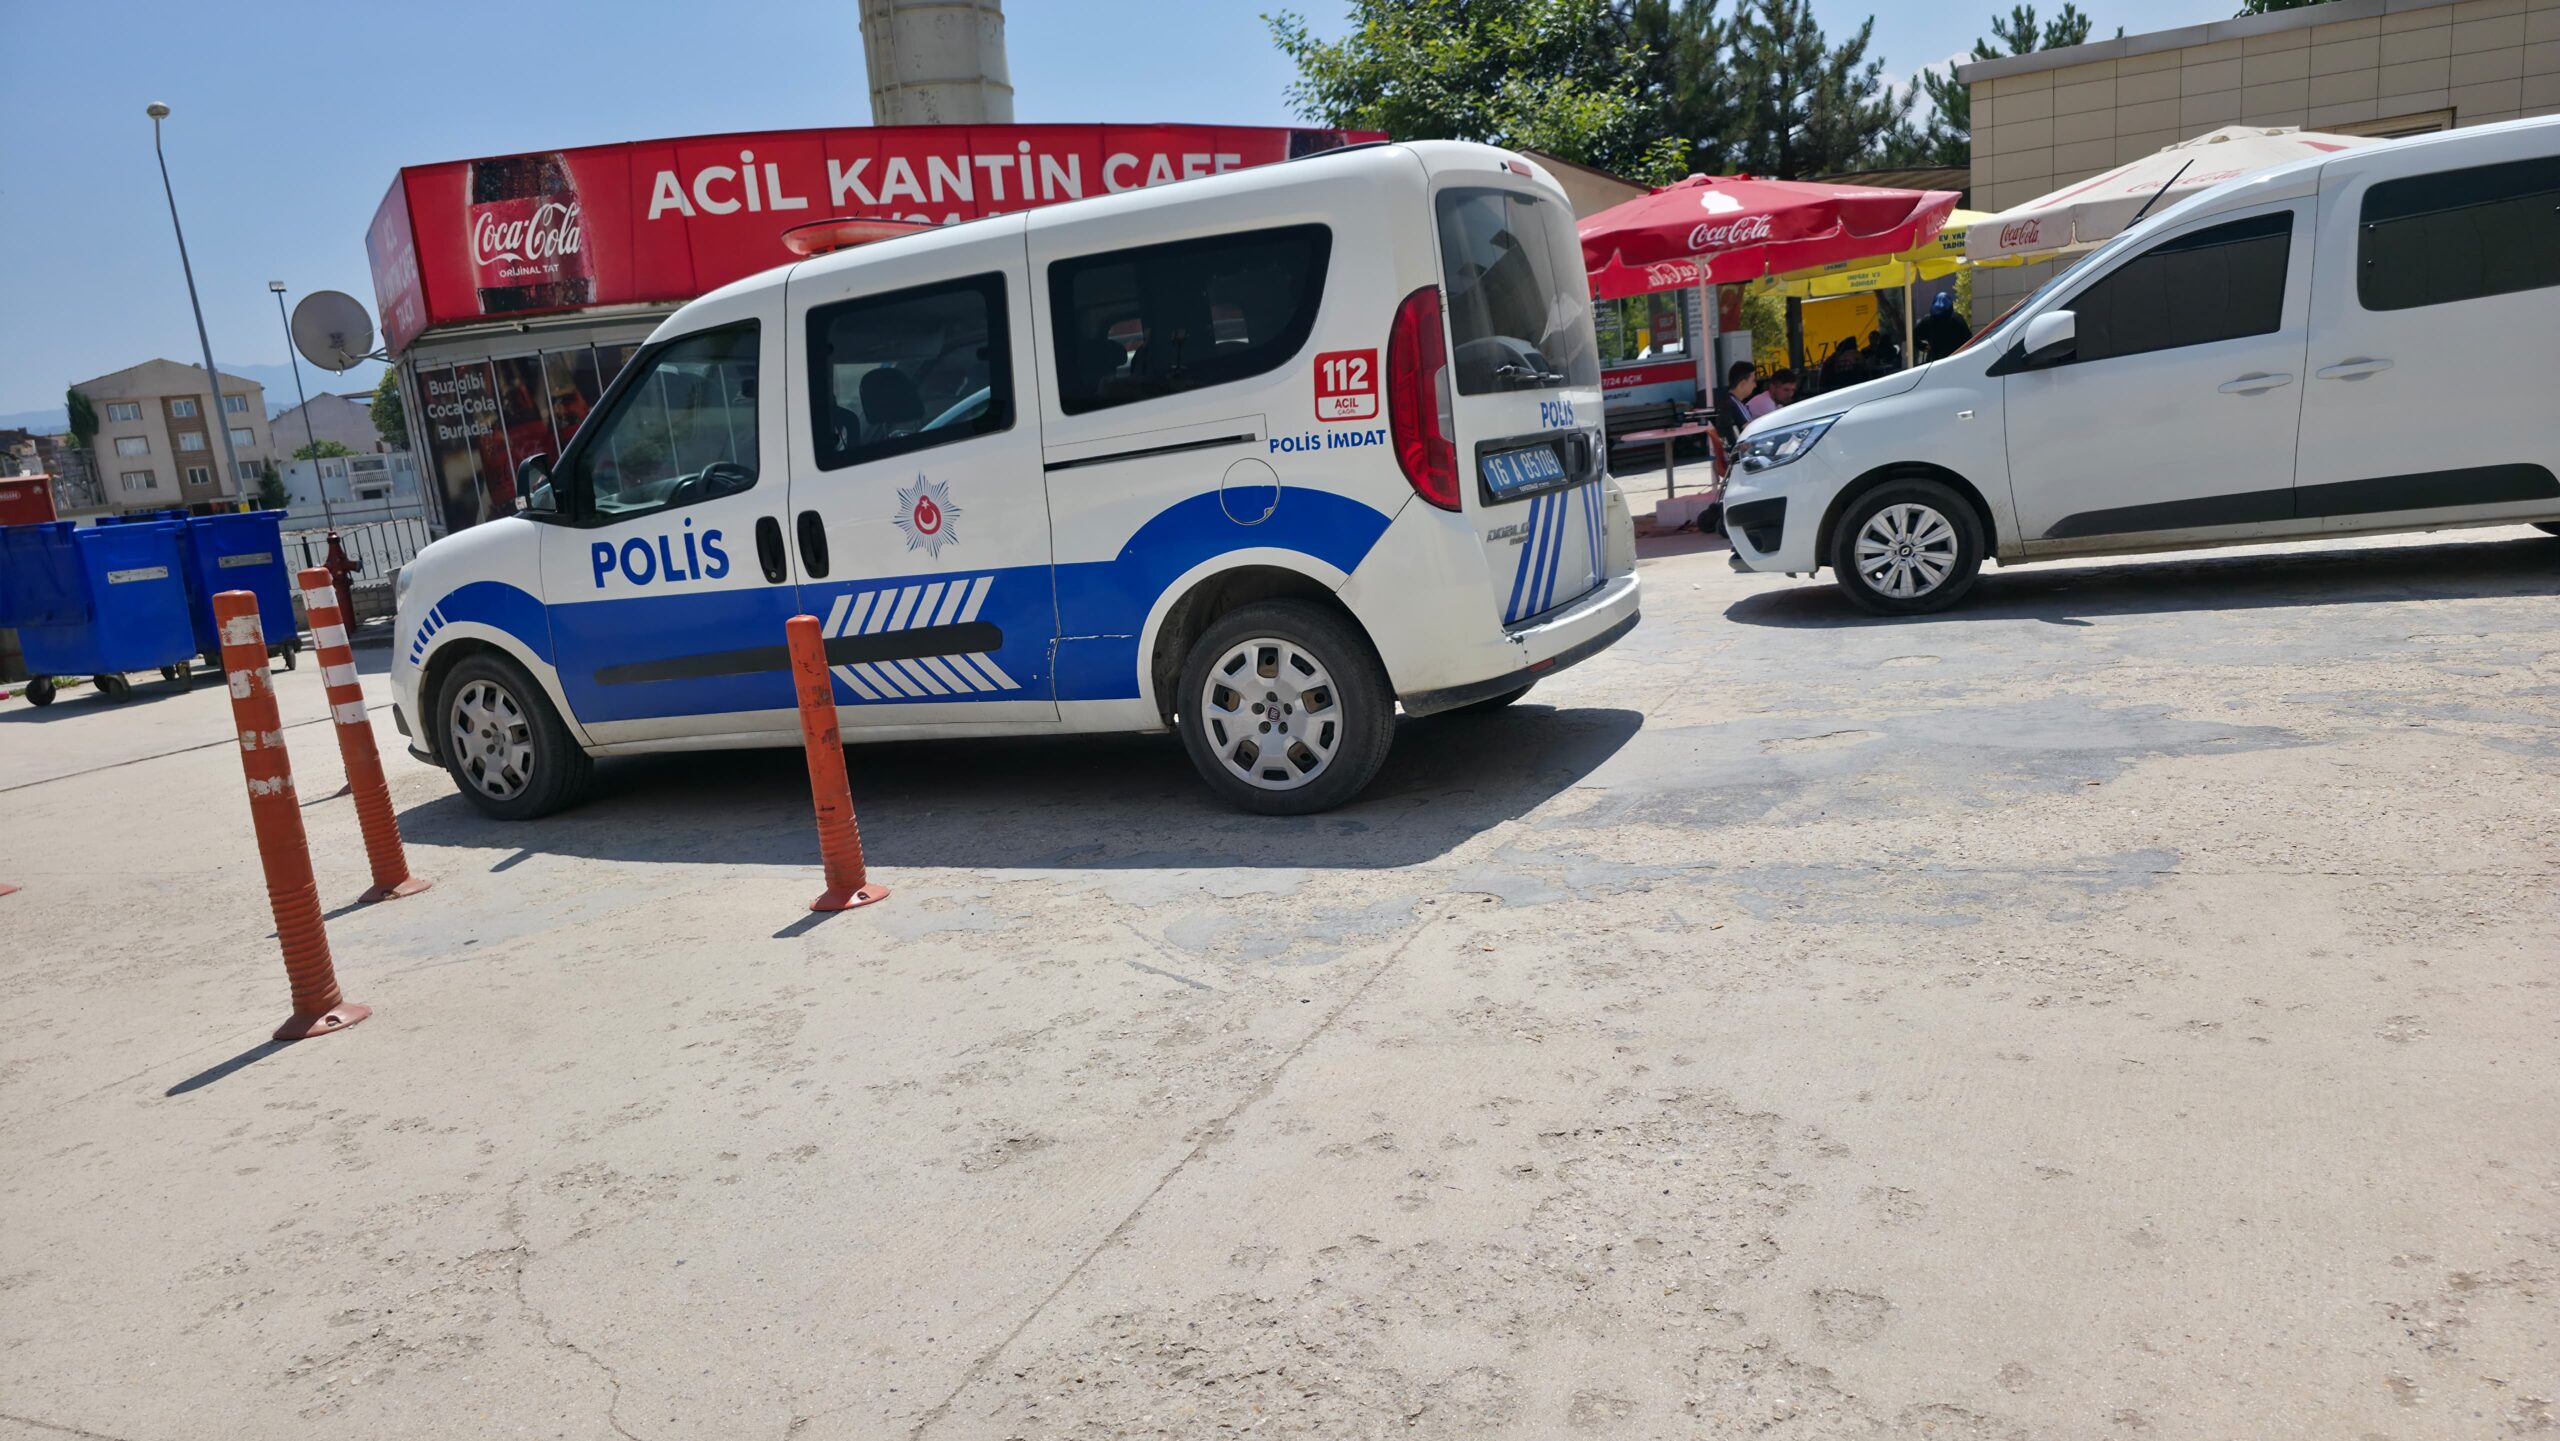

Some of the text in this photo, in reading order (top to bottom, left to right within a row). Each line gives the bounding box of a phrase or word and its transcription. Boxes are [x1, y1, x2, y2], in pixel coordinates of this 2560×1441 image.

[648, 149, 808, 220] ACİL
[826, 140, 1083, 207] KANTİN
[474, 202, 581, 266] Coca-Cola
[1688, 214, 1773, 250] Coca-Cola
[2000, 218, 2040, 248] Coca-Cola
[543, 264, 560, 273] TAT
[428, 372, 486, 396] Buz gibi
[1323, 357, 1368, 391] 112
[1269, 429, 1386, 453] POLİS İMDAT
[1488, 458, 1510, 486] 16
[1509, 456, 1524, 481] A
[591, 517, 730, 588] POLİS
